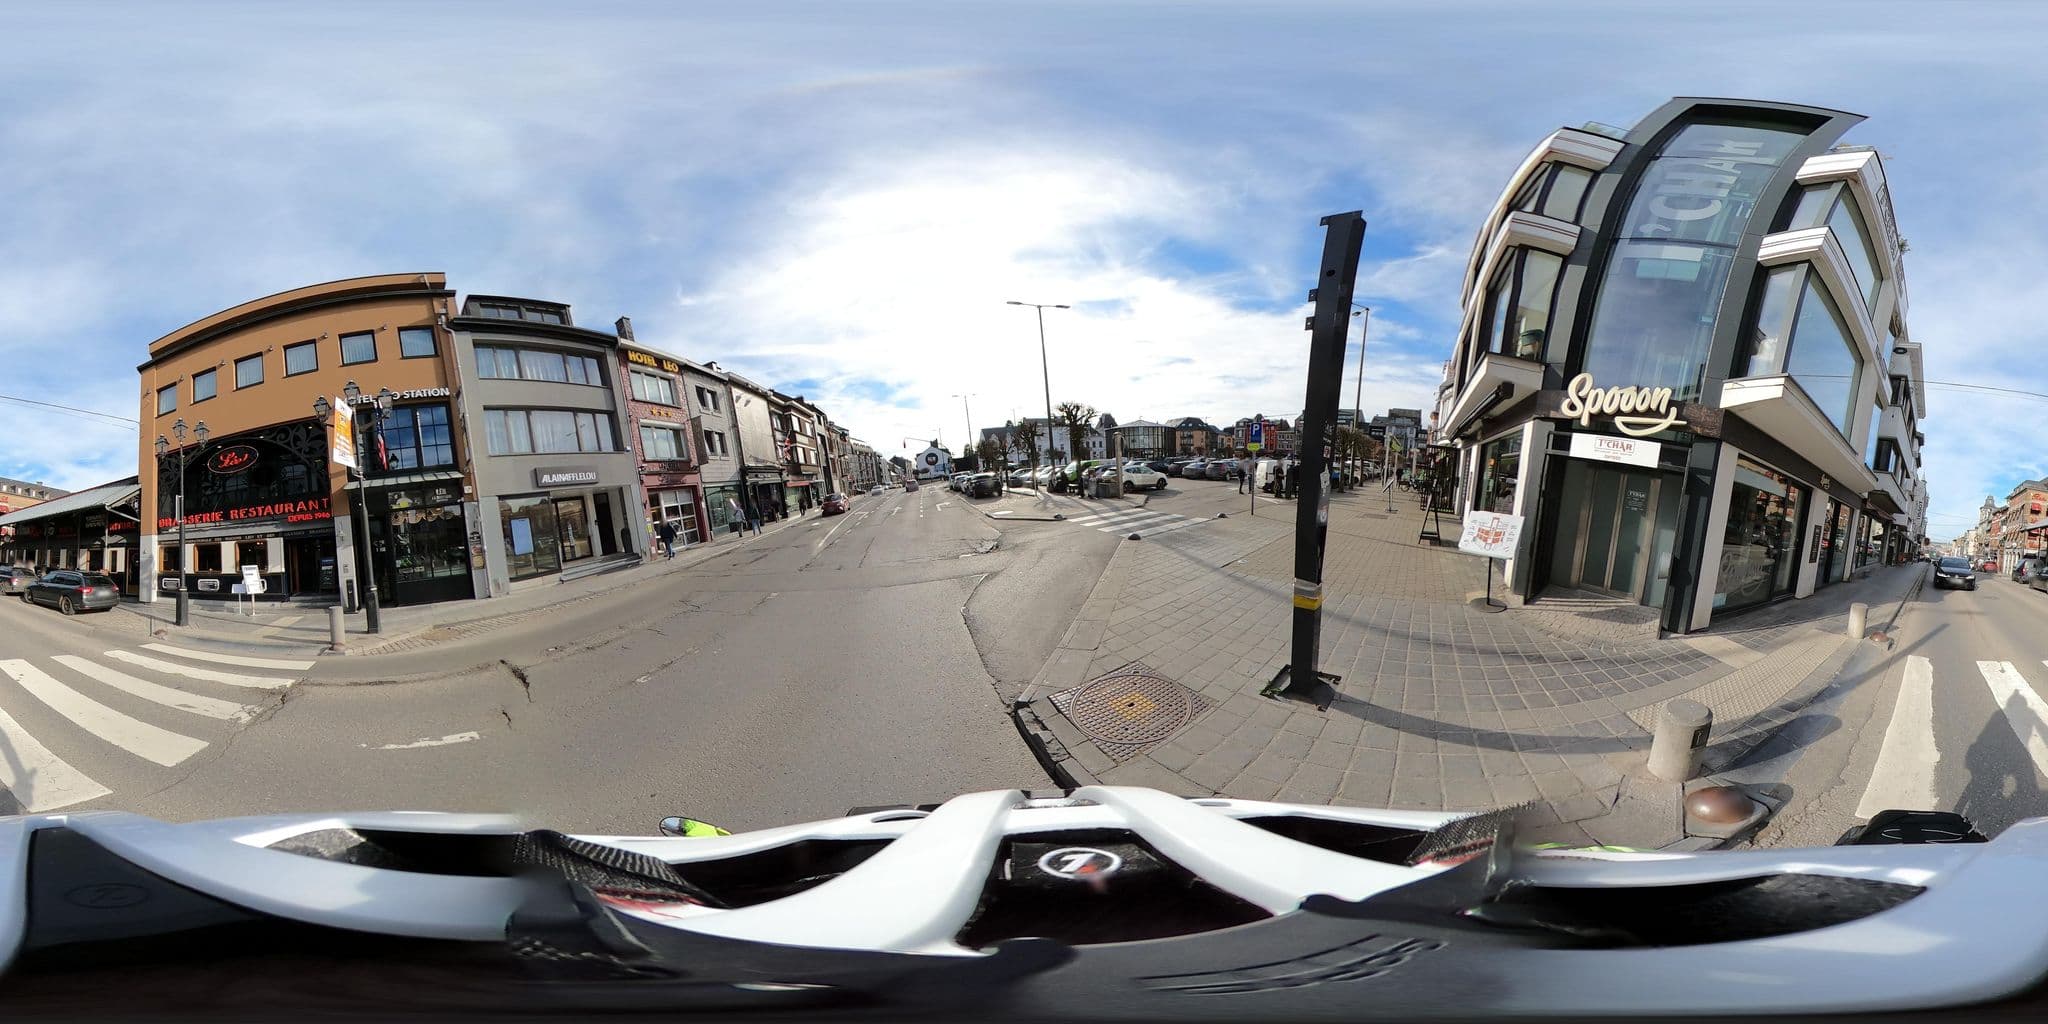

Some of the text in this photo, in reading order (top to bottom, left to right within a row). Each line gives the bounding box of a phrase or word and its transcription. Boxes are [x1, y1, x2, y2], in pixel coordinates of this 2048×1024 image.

[628, 350, 657, 367] HOTEL
[403, 387, 450, 399] STATION
[1561, 372, 1676, 427] Spooon
[1252, 423, 1260, 435] P
[230, 499, 329, 520] RESTAURANT
